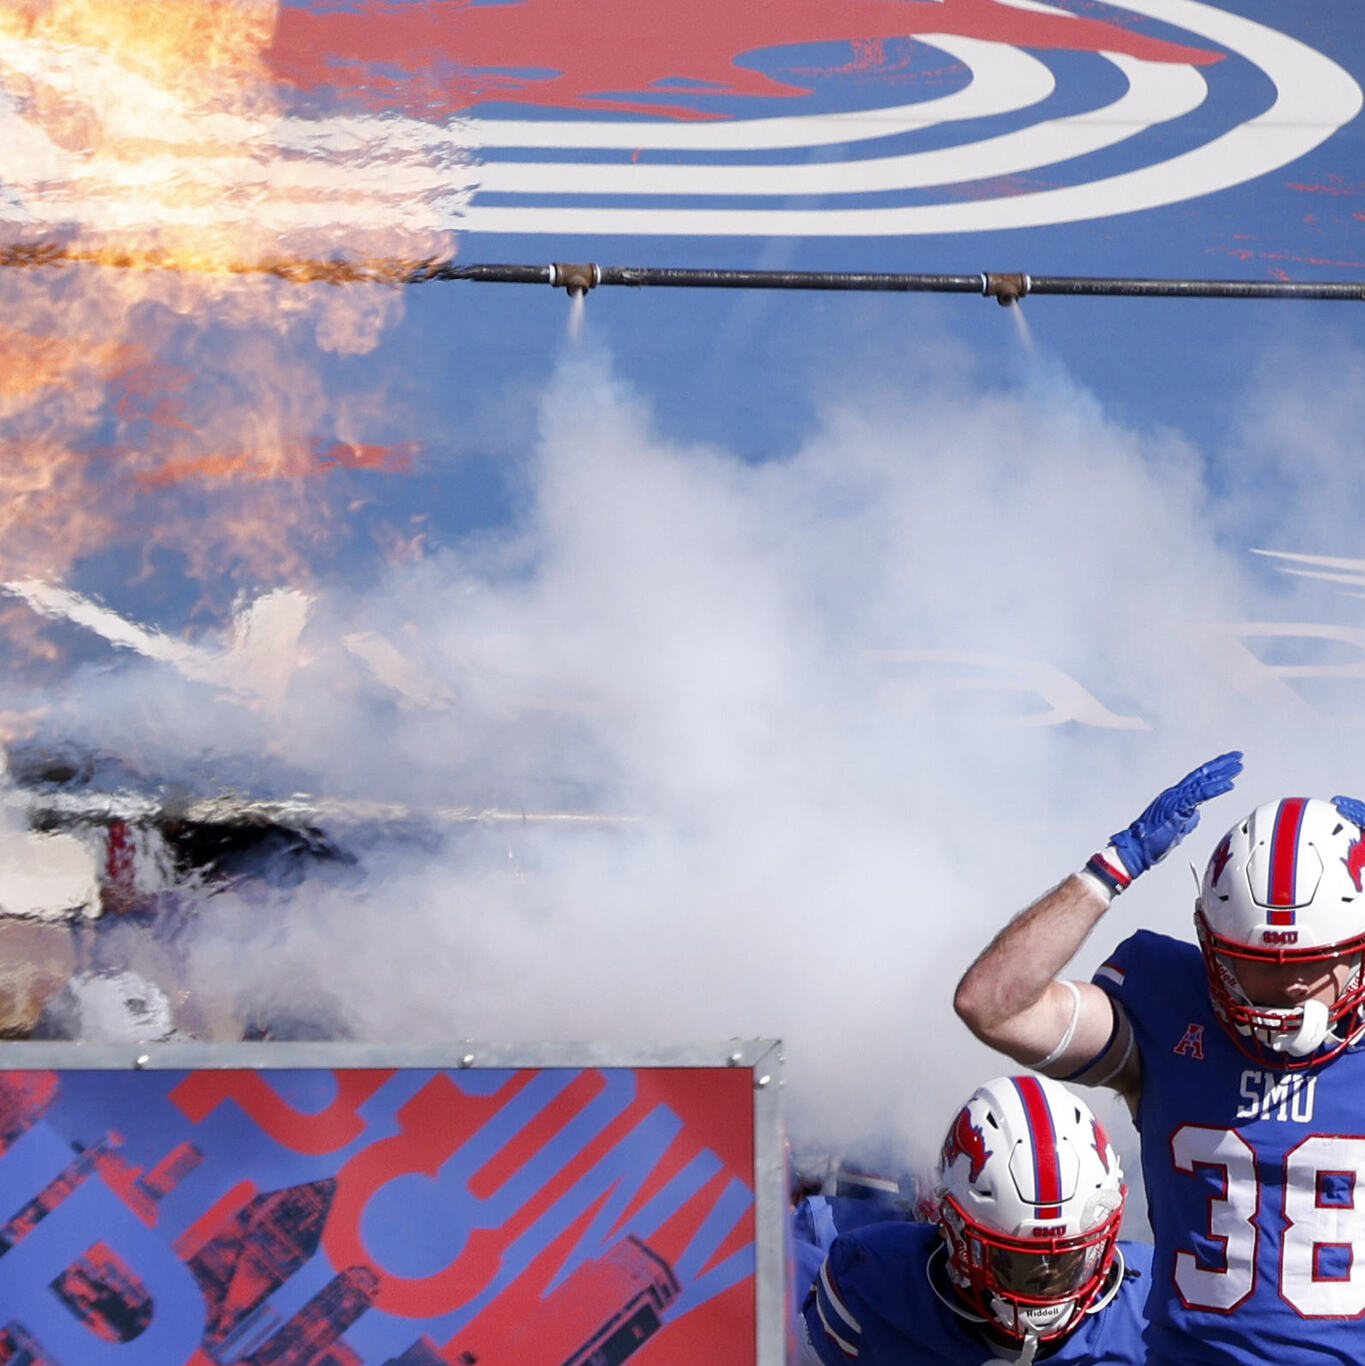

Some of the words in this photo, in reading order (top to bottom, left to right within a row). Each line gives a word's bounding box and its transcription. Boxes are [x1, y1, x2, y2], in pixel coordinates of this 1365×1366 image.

[1262, 929, 1300, 947] SMU
[1236, 1070, 1318, 1124] SMU
[1032, 1224, 1068, 1238] SMU
[1026, 1307, 1060, 1319] Riddell
